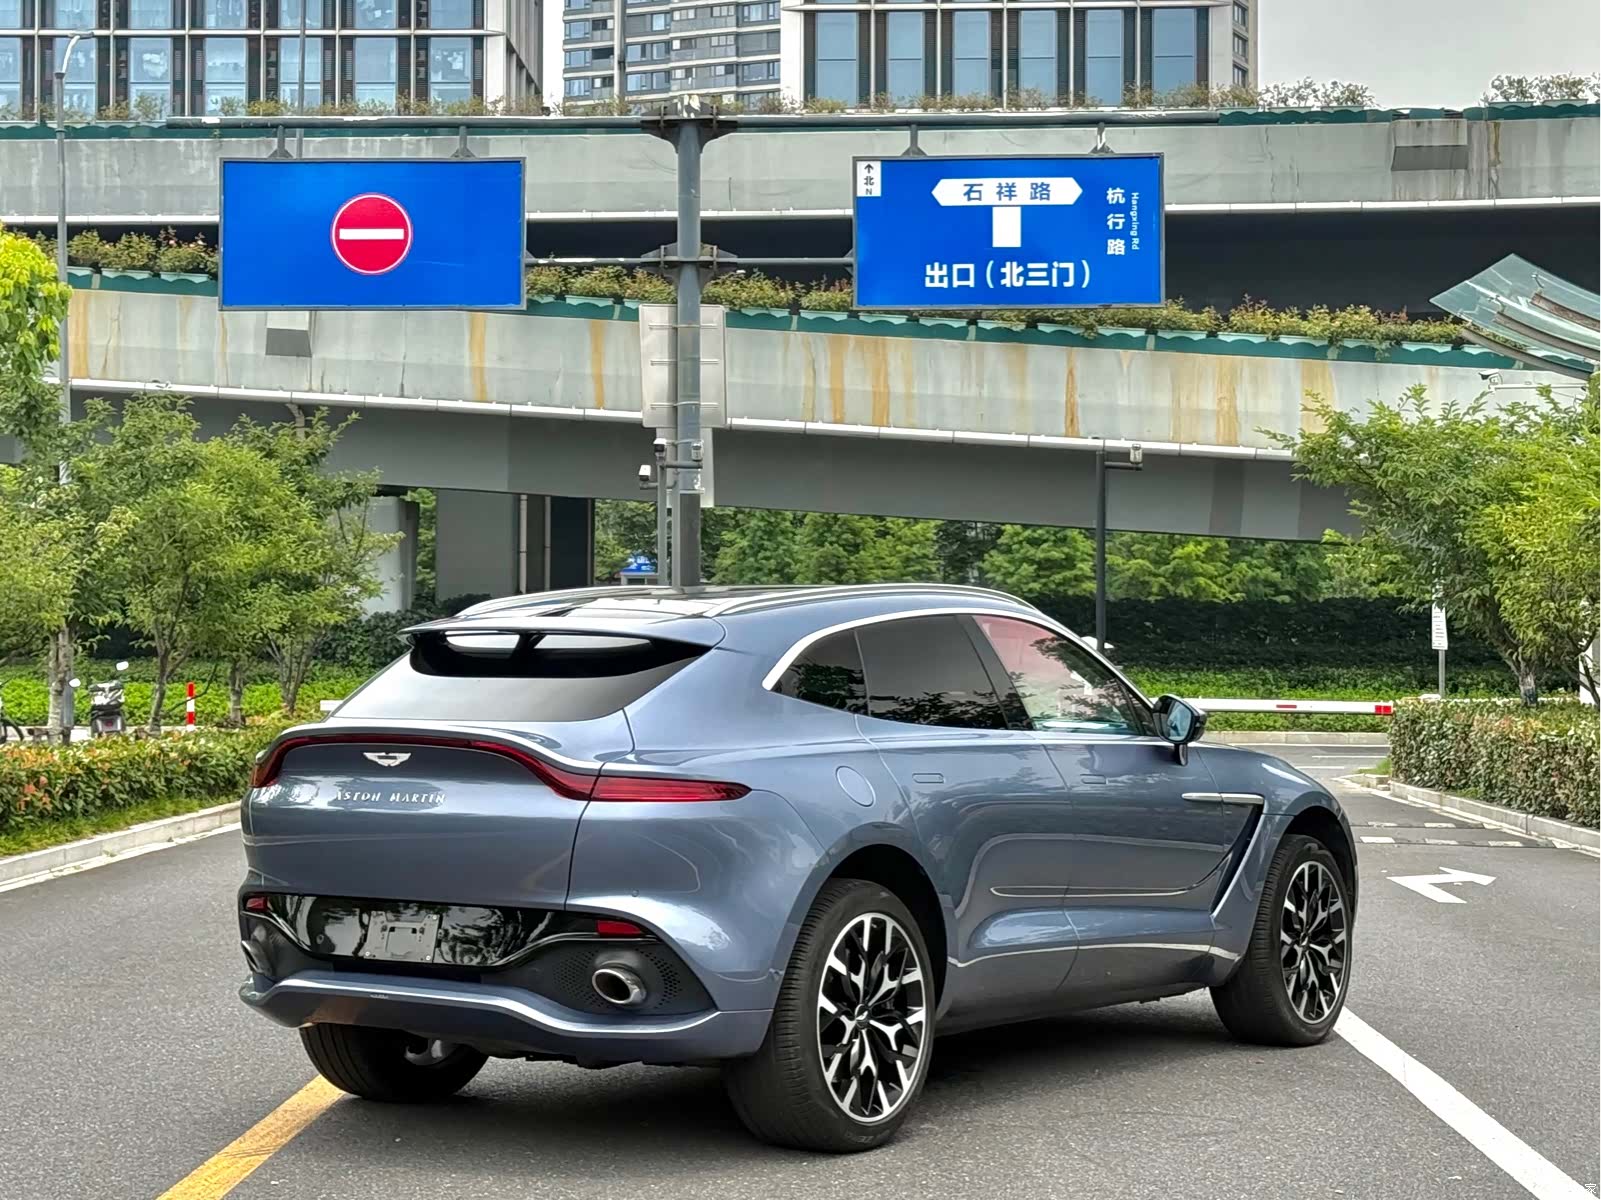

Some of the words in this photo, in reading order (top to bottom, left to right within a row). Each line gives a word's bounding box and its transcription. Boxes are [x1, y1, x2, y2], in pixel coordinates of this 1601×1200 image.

[863, 175, 875, 186] 北
[963, 182, 1051, 202] 石祥路
[1106, 187, 1126, 256] 杭行路
[1130, 192, 1139, 236] Hangxing
[1131, 238, 1140, 250] Rd
[336, 791, 381, 802] ASTON
[389, 792, 446, 803] MARTIN
